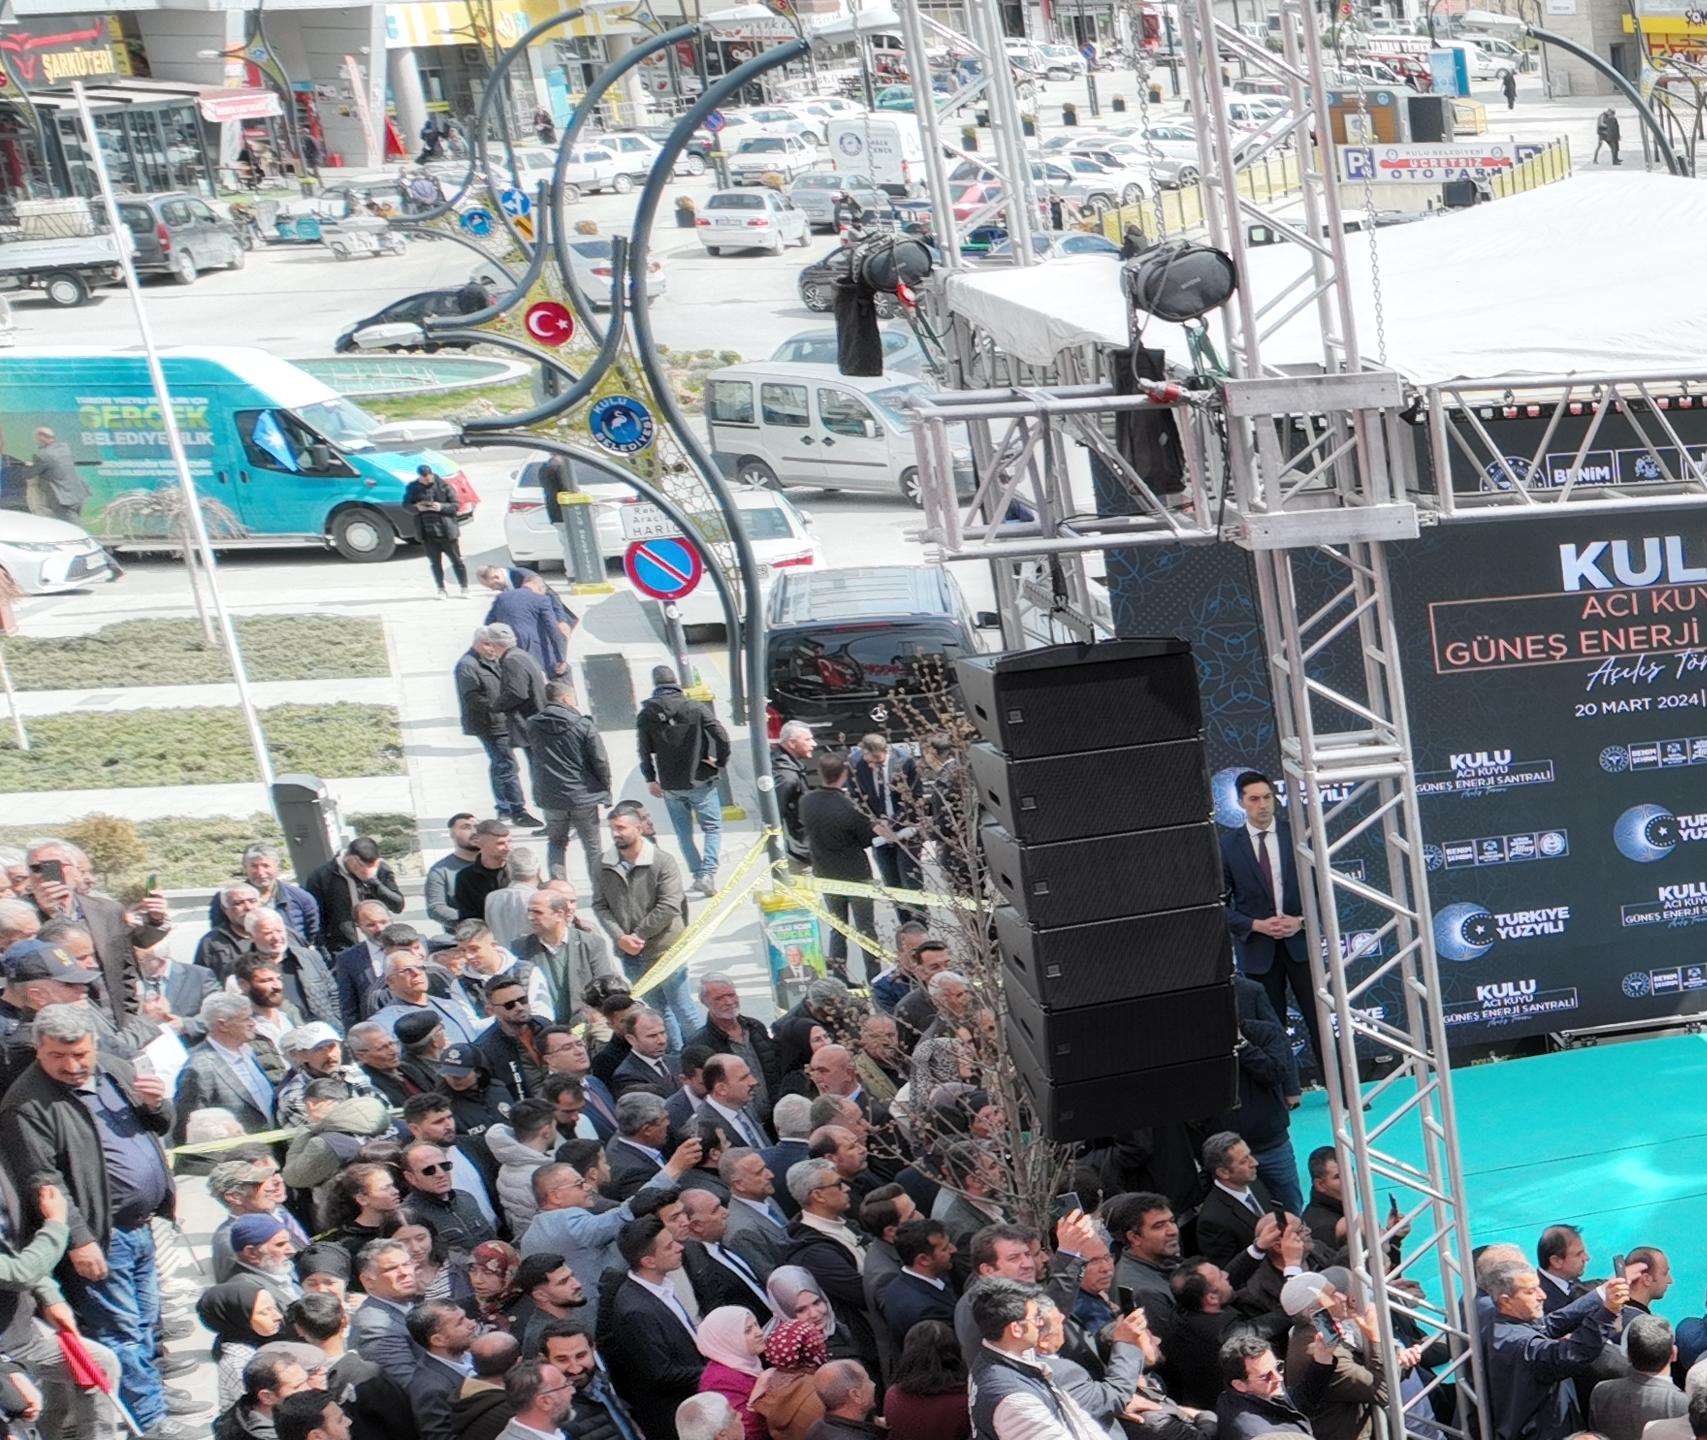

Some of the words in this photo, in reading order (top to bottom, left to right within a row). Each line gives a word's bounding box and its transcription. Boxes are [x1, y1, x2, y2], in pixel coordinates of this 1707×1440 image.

[42, 46, 116, 84] ŞARKÜTERİ
[1390, 169, 1433, 179] OTO
[594, 396, 627, 414] KULU
[1582, 593, 1638, 620] ACI
[1445, 633, 1568, 666] GÜNEŞ
[1581, 615, 1700, 655] ENERJİ
[1575, 702, 1597, 717] 20
[1602, 697, 1652, 714] MART
[1450, 749, 1512, 771] KULU
[1478, 765, 1508, 775] KUYU
[1476, 979, 1537, 1000] KULU
[1504, 995, 1533, 1005] KUYU
